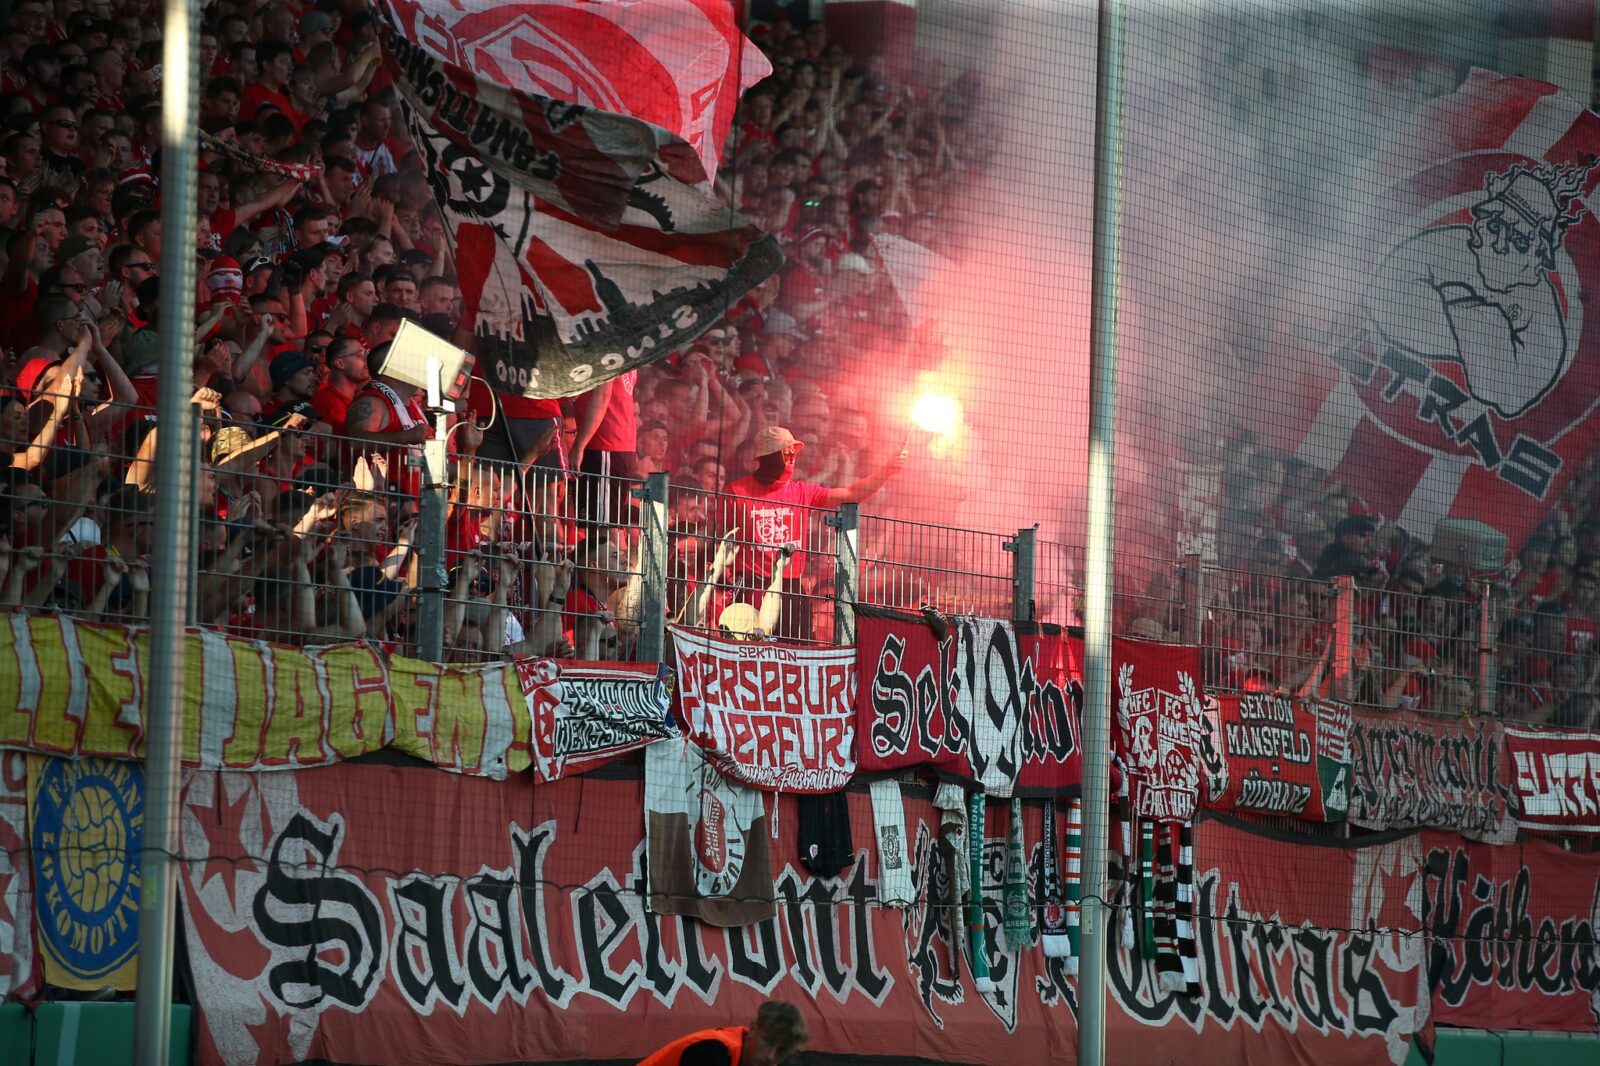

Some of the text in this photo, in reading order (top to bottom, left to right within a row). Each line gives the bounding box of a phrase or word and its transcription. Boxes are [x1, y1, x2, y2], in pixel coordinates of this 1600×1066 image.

[739, 646, 797, 662] SEKTION
[558, 678, 666, 721] SEKTION
[1240, 693, 1294, 723] SEKTION
[1226, 723, 1311, 763] MANSFELD
[1236, 770, 1312, 814] SÜDHARZ
